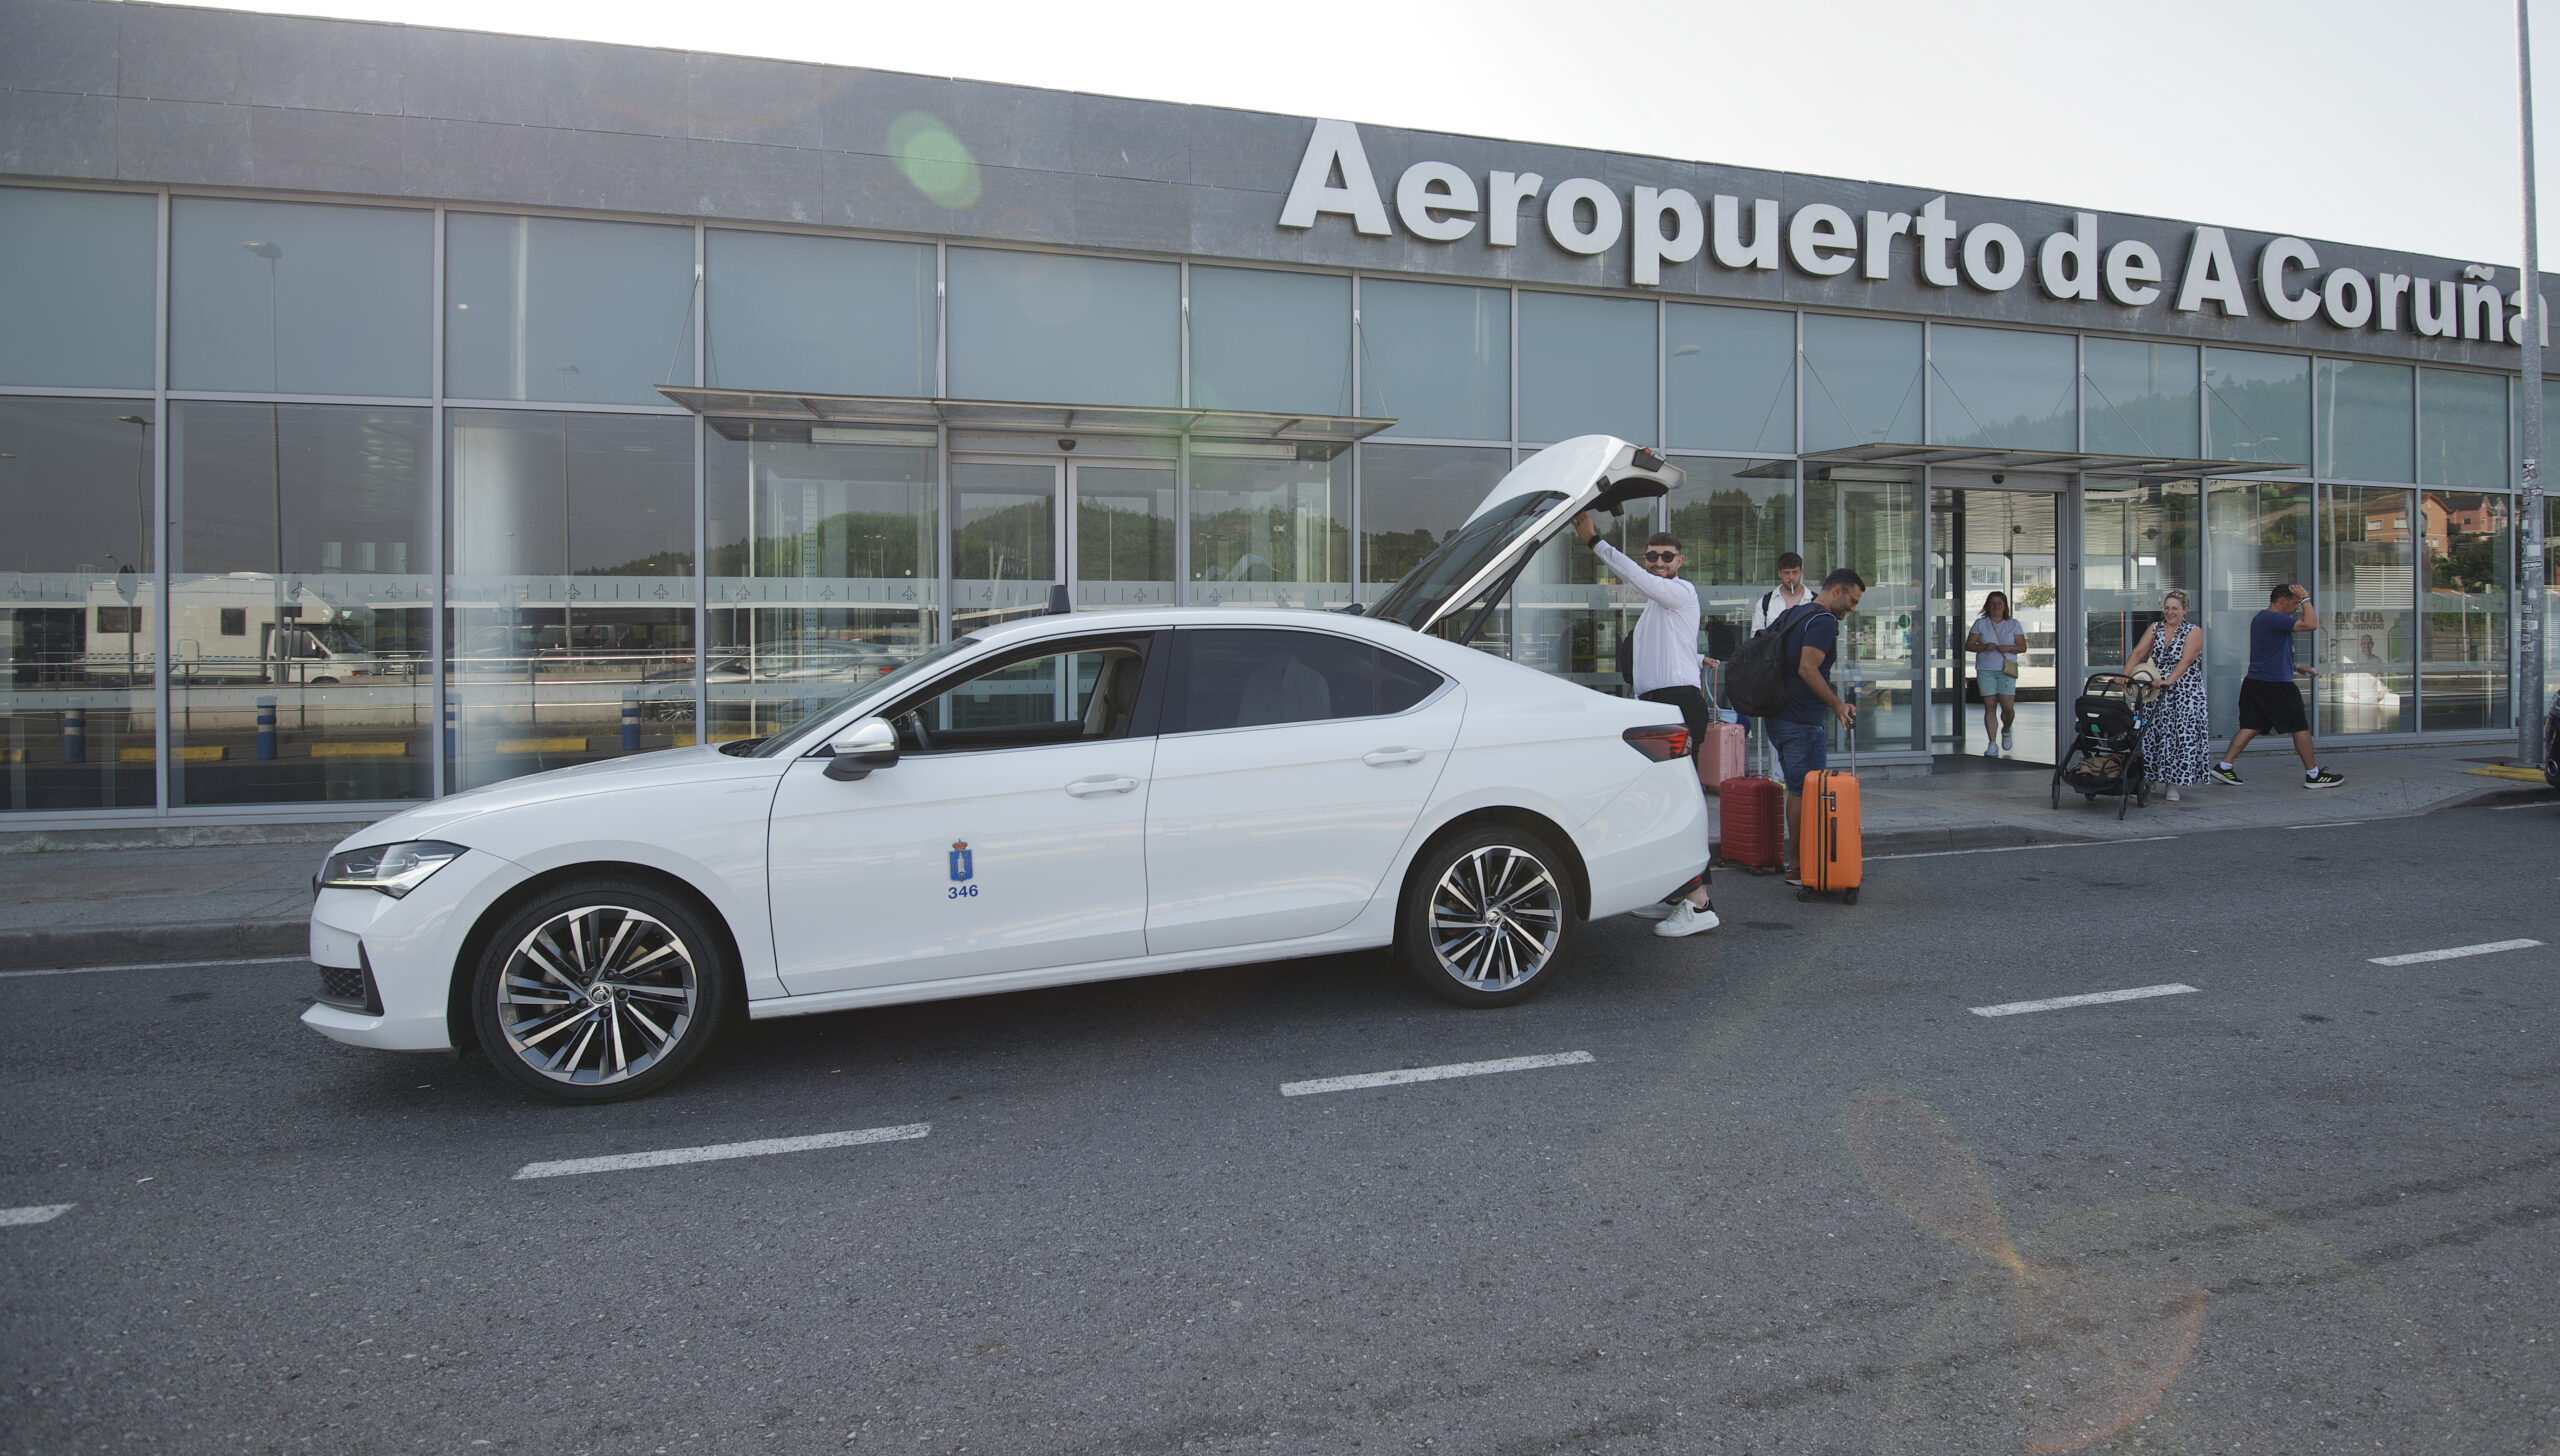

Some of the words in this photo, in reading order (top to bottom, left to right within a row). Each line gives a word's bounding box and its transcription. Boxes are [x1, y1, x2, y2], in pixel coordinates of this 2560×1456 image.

[1278, 117, 2025, 292] Aeropuerto
[2037, 212, 2161, 307] de
[2174, 226, 2249, 317] A
[948, 885, 978, 899] 346
